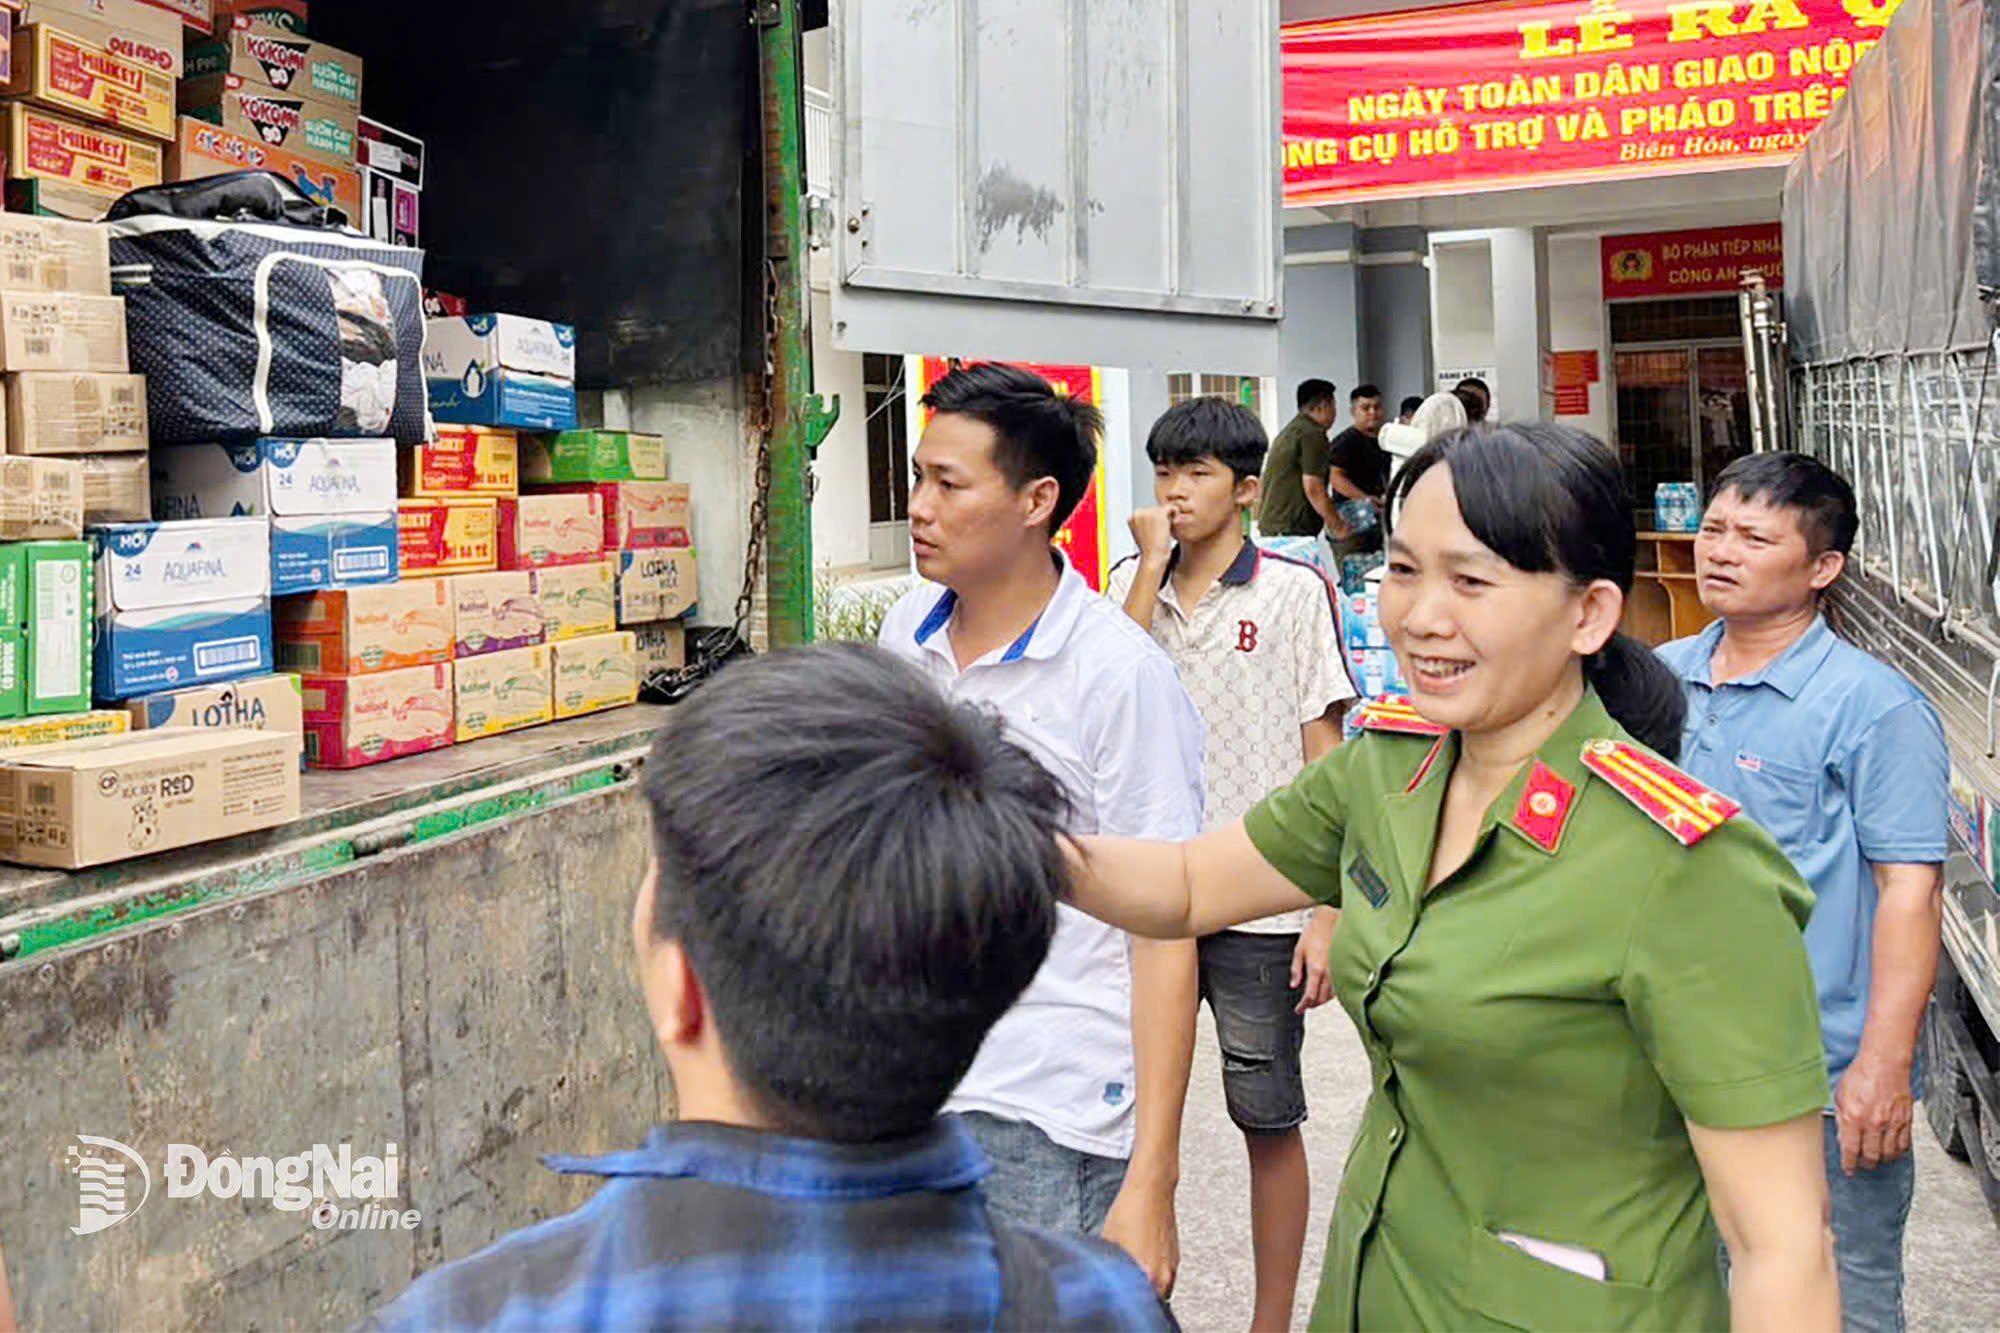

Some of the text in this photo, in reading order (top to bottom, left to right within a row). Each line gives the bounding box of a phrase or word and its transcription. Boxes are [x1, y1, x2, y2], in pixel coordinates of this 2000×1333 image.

[1668, 0, 1810, 42] RA
[1347, 82, 1449, 125] NGÀY
[1459, 73, 1561, 112] TOÀN
[1574, 62, 1660, 99] DÂN
[1673, 51, 1775, 88] GIAO
[1281, 139, 1339, 168] NG
[1348, 132, 1399, 165] CỤ
[1469, 114, 1545, 151] TRỢ
[1556, 106, 1610, 142] VÀ
[1620, 96, 1736, 136] PHÁO
[1619, 142, 1676, 161] Biên
[1668, 266, 1713, 284] CÔNG
[1715, 265, 1738, 281] AN
[309, 473, 361, 494] AQUAFINA
[123, 563, 142, 577] 24
[163, 559, 227, 583] AQUAFINA
[1234, 619, 1258, 653] B
